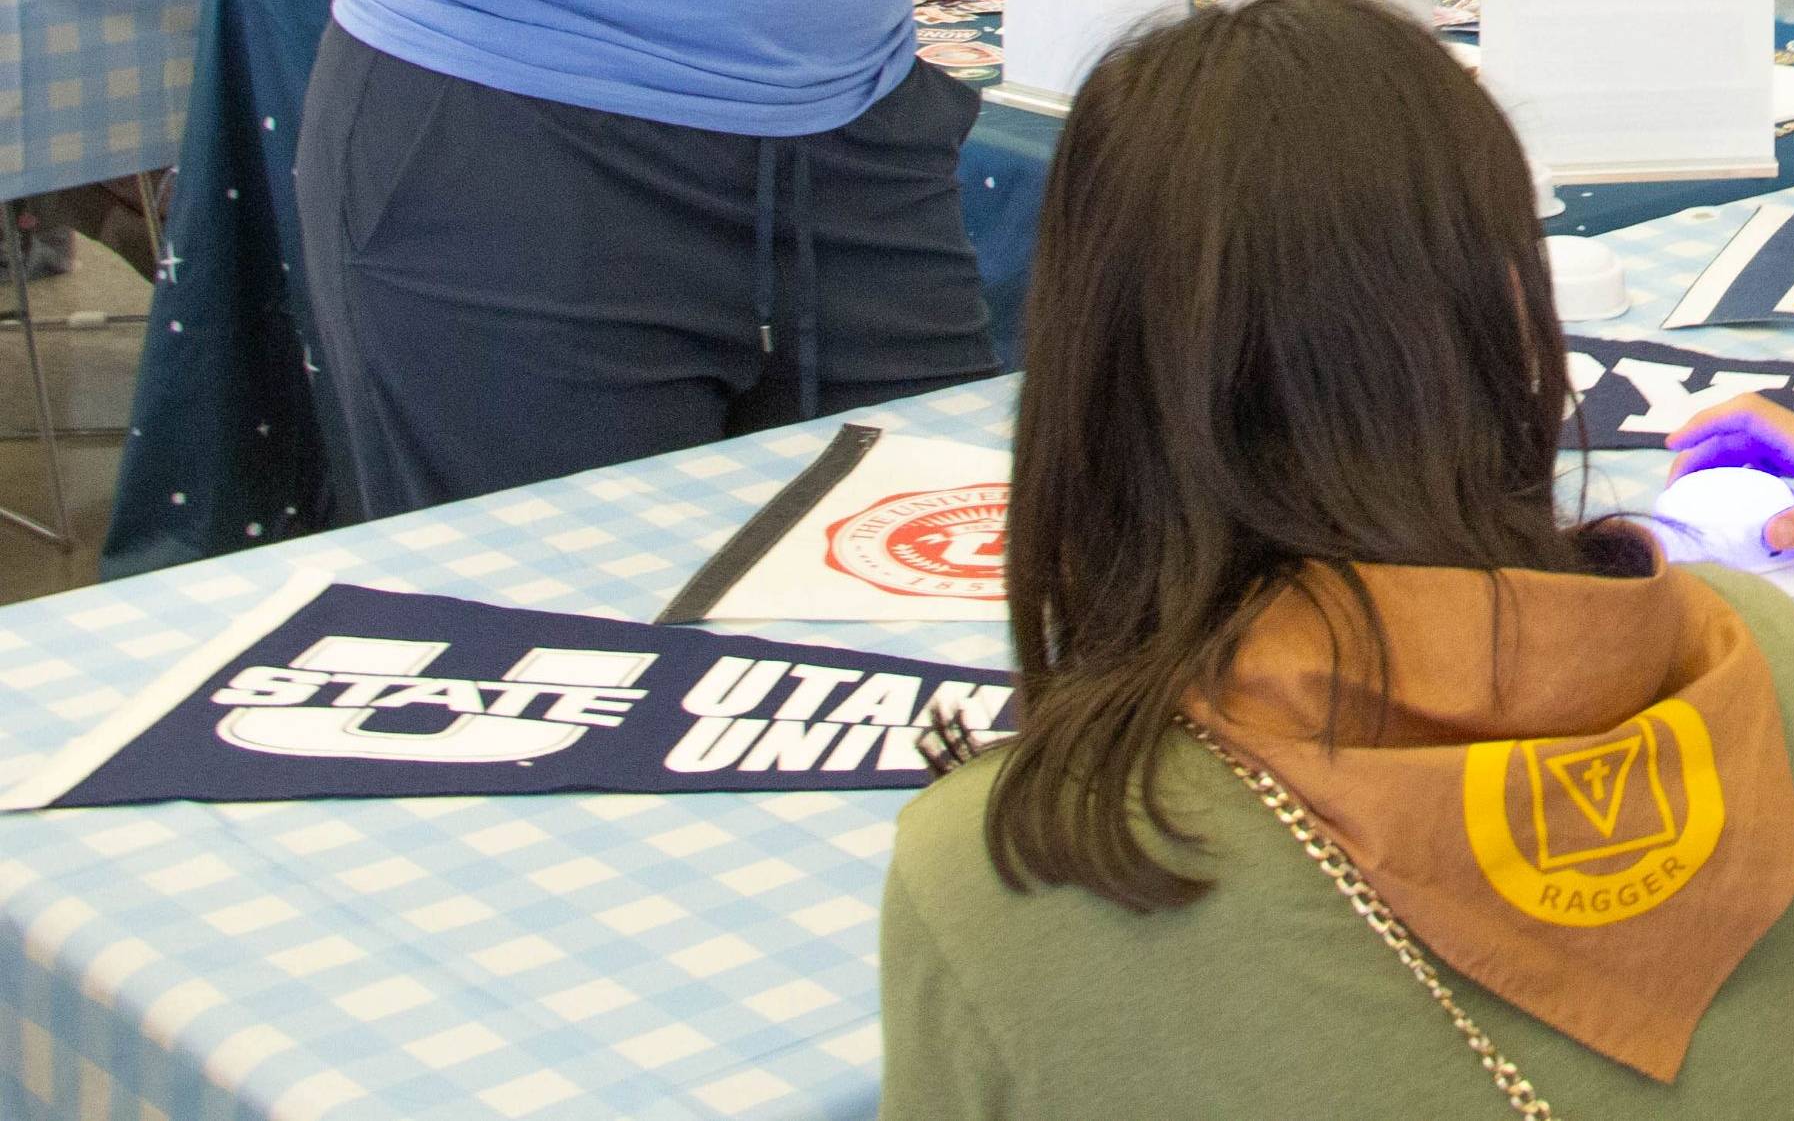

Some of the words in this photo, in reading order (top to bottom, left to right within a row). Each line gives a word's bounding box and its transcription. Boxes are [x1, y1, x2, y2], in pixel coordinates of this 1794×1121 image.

[850, 511, 890, 540] THE
[889, 491, 1009, 517] UNIVE
[909, 577, 1009, 592] 185
[210, 665, 648, 727] STATE
[1538, 856, 1687, 913] RAGGER
